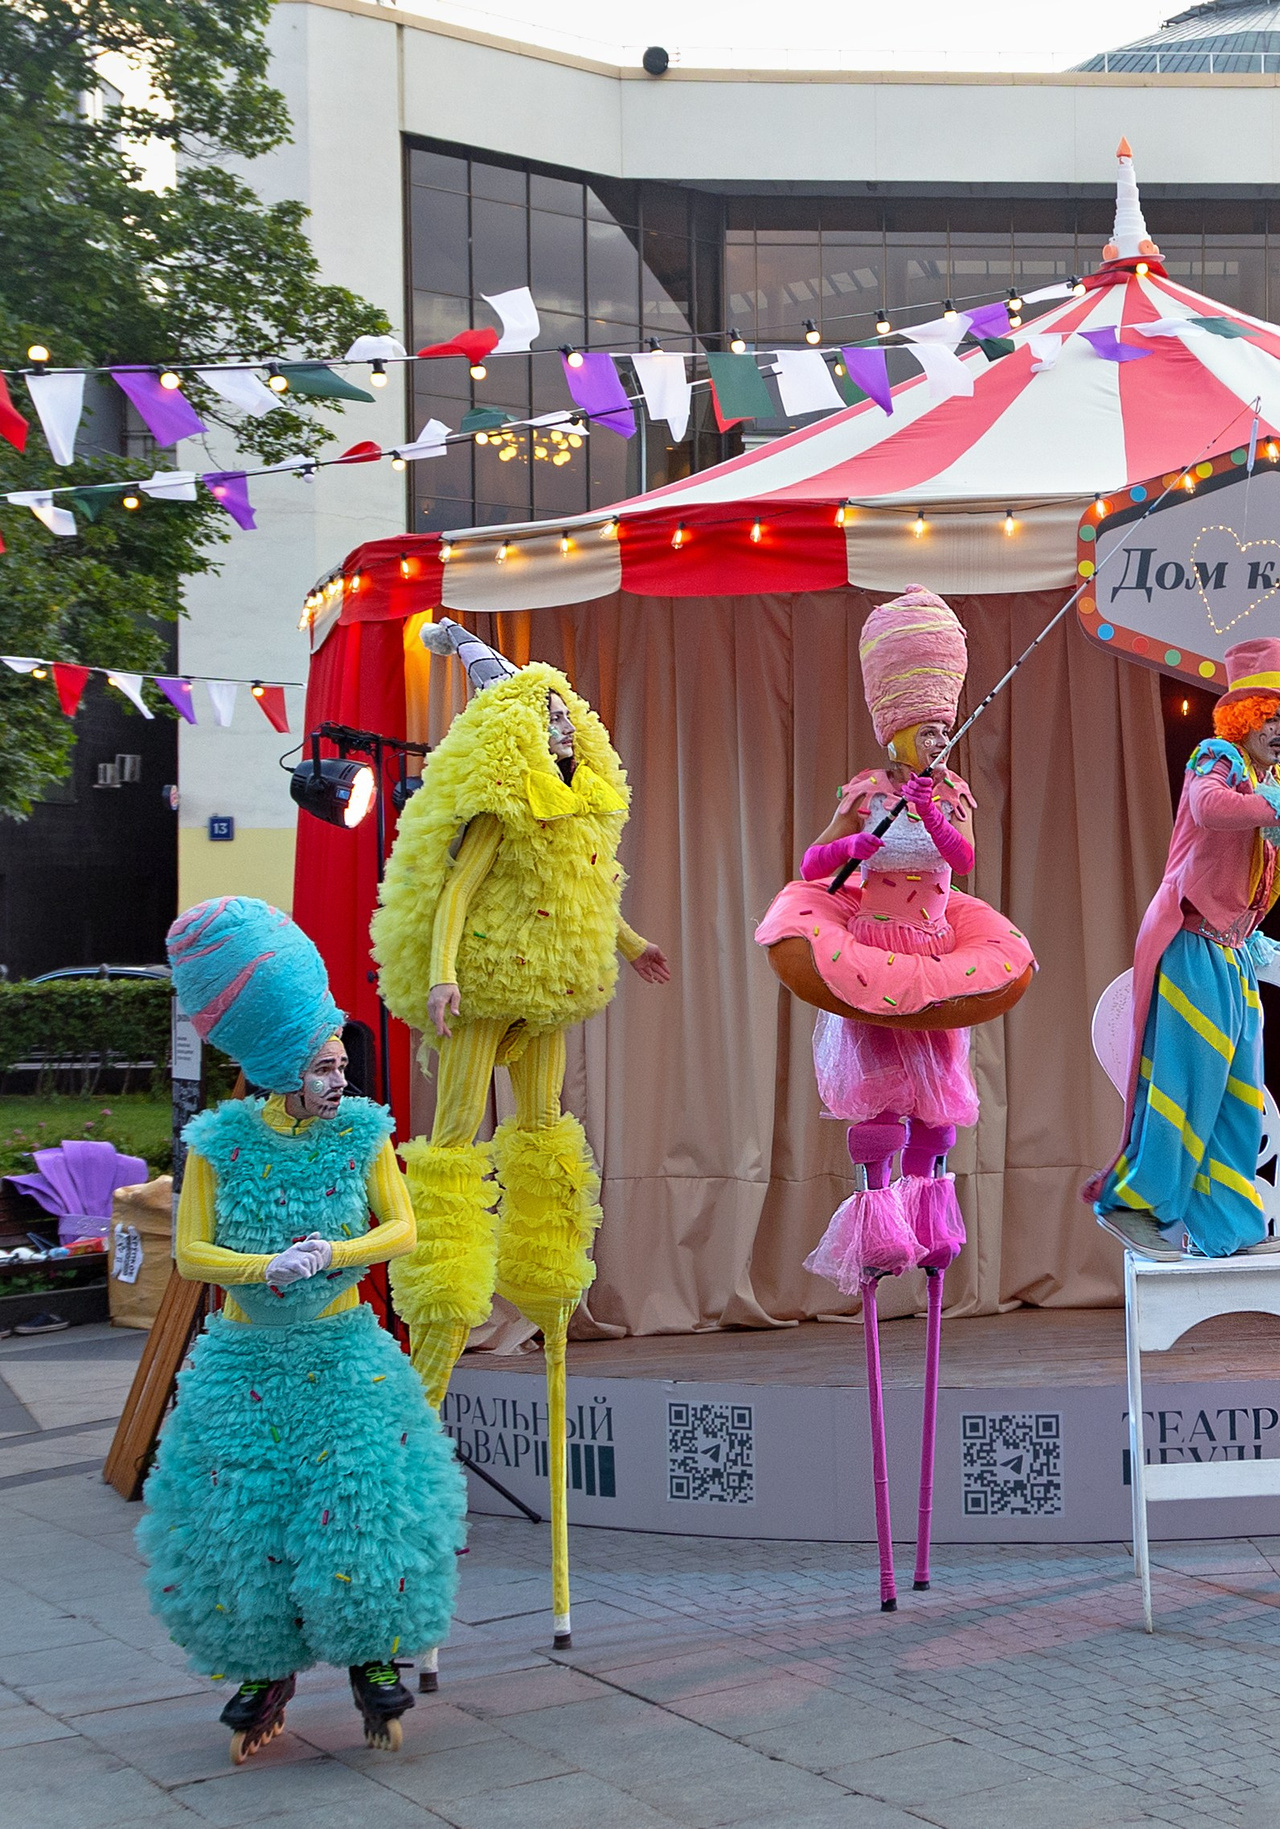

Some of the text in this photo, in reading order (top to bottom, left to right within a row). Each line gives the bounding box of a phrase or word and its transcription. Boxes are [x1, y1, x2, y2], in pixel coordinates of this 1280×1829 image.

[1110, 547, 1228, 603] Дом
[212, 822, 228, 835] 13
[443, 1391, 614, 1441] ТРАЛЬНЫЙ
